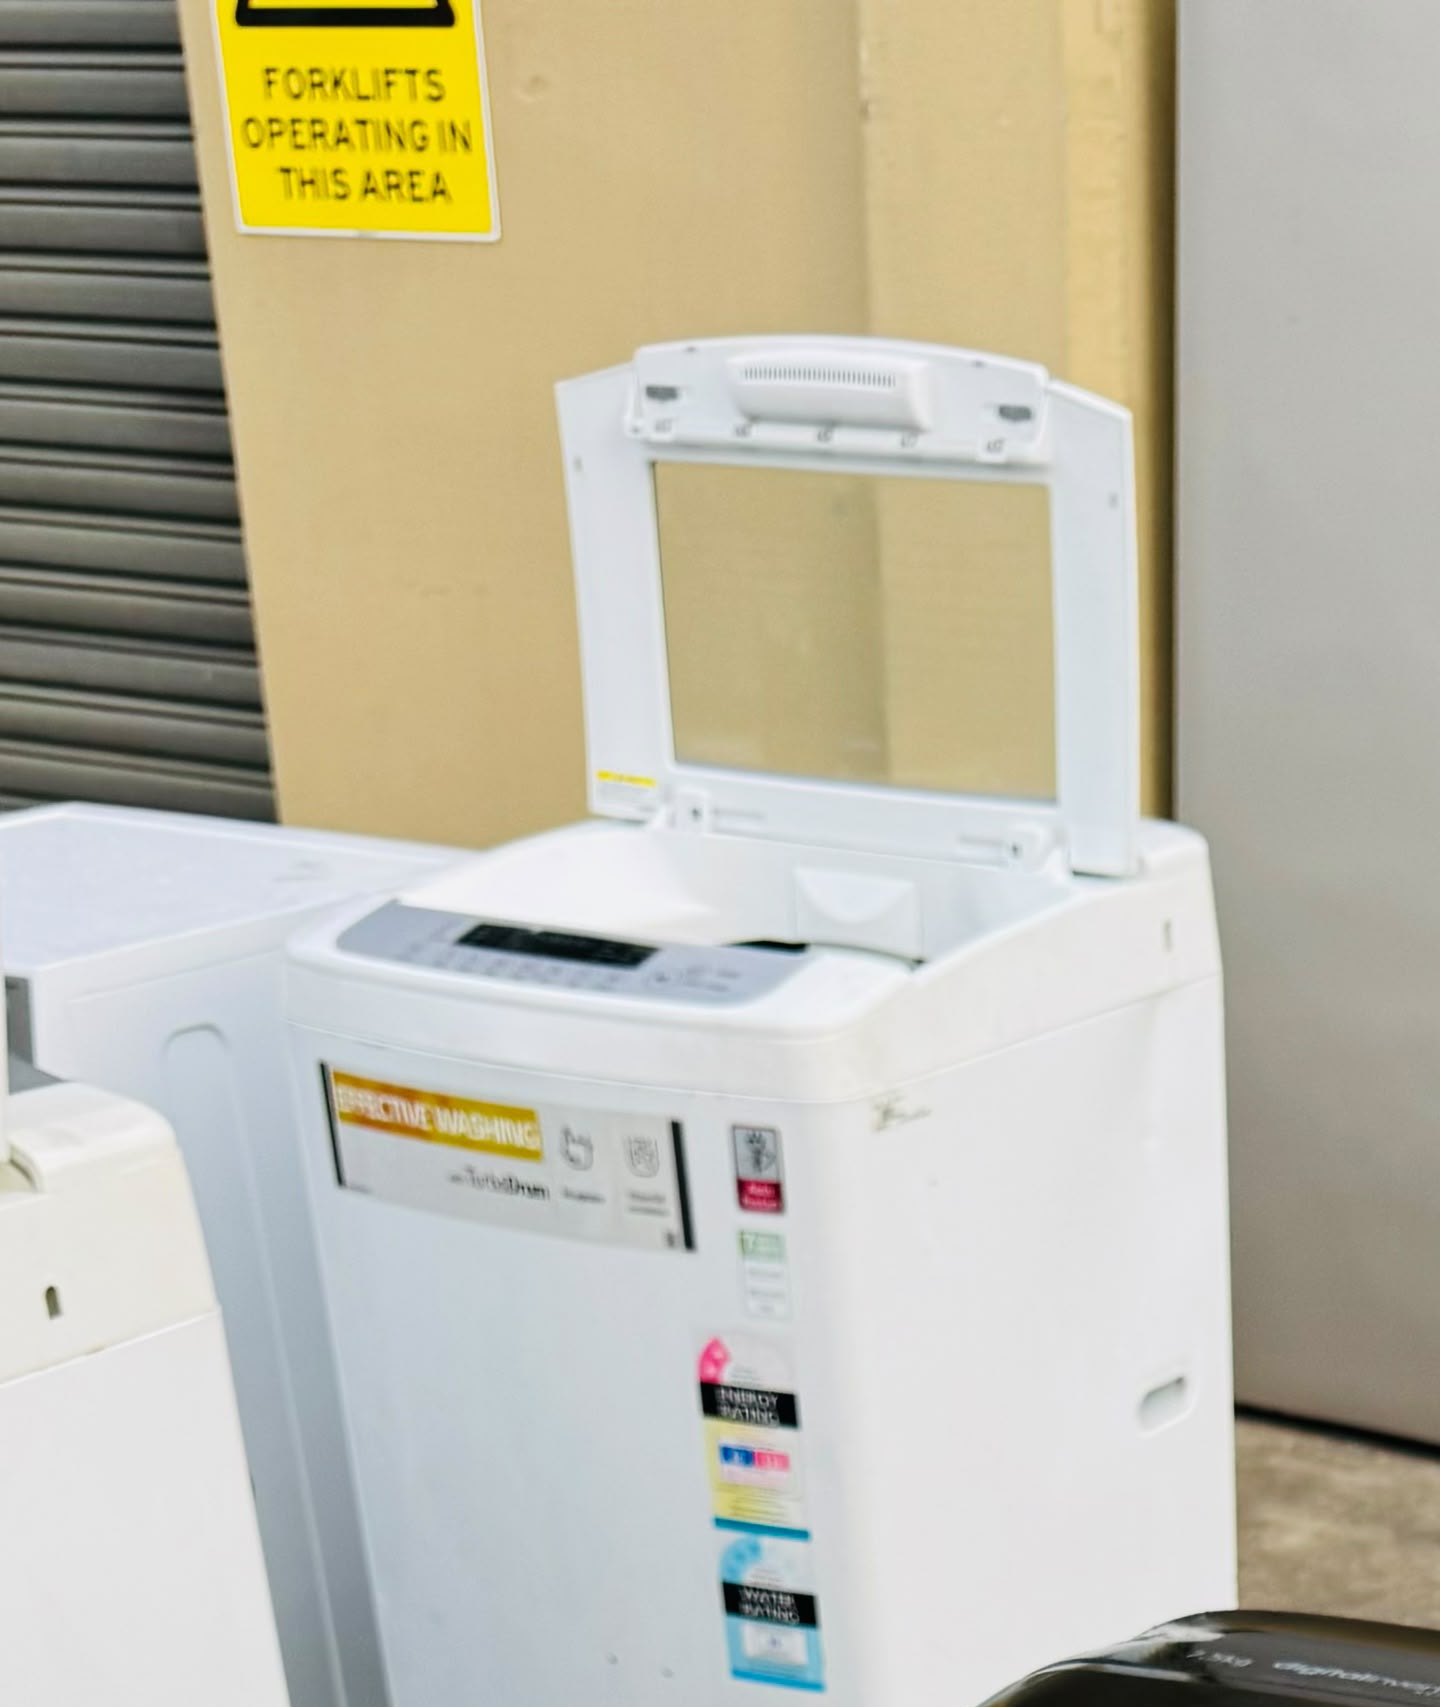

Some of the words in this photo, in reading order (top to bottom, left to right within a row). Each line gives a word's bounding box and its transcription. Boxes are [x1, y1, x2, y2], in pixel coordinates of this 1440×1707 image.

[263, 67, 446, 101] FORKLIFTS
[242, 118, 430, 152] OPERATING
[437, 120, 473, 152] IN
[278, 166, 351, 200] THIS
[362, 169, 453, 203] AREA
[436, 1108, 540, 1152] WASHING
